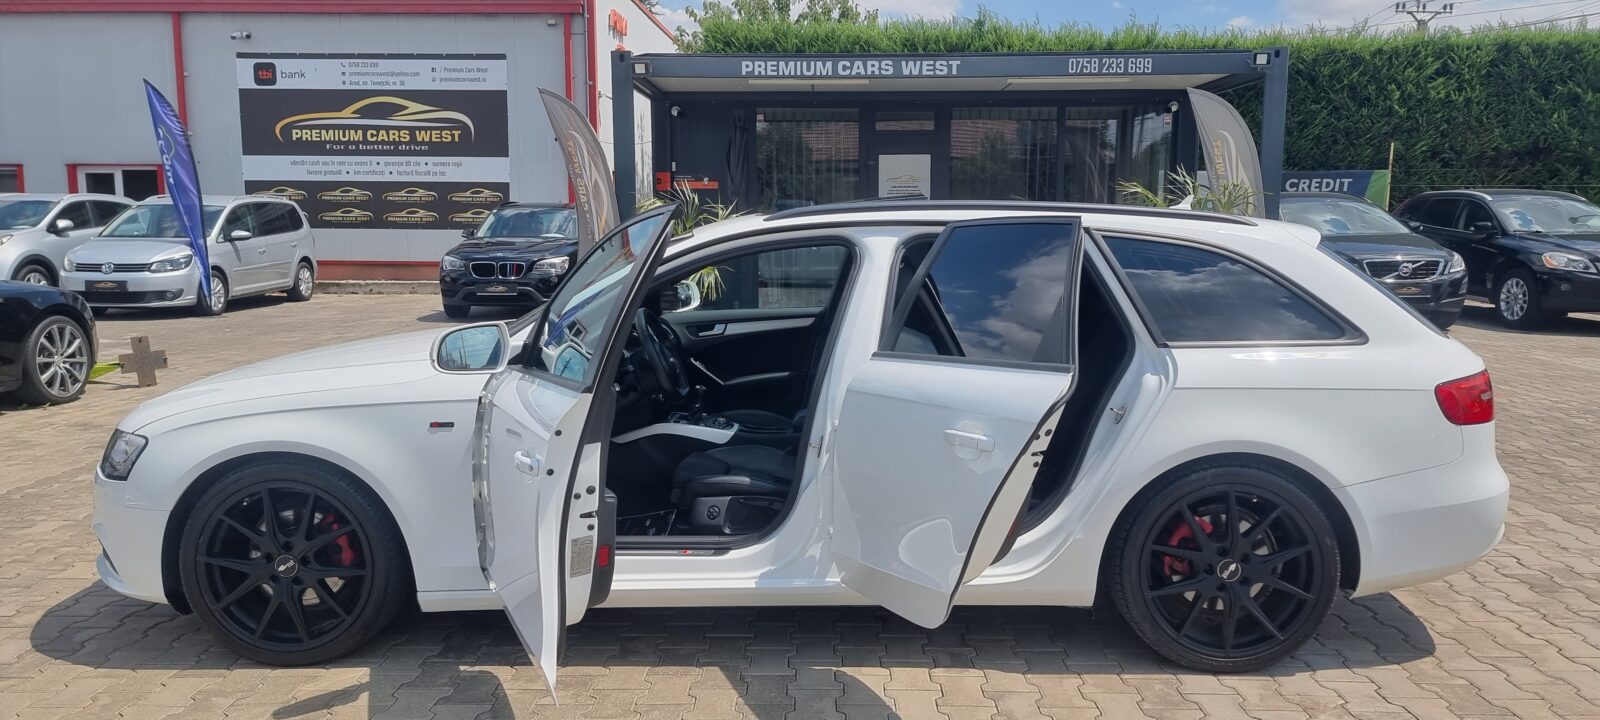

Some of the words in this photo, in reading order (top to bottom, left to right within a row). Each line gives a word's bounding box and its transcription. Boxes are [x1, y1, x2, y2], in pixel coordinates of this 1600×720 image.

[443, 66, 465, 74] Premium
[465, 66, 476, 74] Cars
[476, 66, 488, 74] West
[741, 60, 832, 76] PREMIUM
[837, 60, 895, 76] CARS
[901, 60, 962, 75] WEST
[1068, 58, 1099, 73] 0758
[1102, 58, 1124, 73] 233
[1128, 58, 1152, 73] 699
[257, 69, 273, 79] tbi
[281, 69, 306, 79] bank
[292, 129, 363, 141] PREMIUM
[367, 129, 411, 142] CARS
[415, 130, 462, 142] WEST
[438, 169, 447, 177] loc
[1284, 178, 1353, 192] CREDIT
